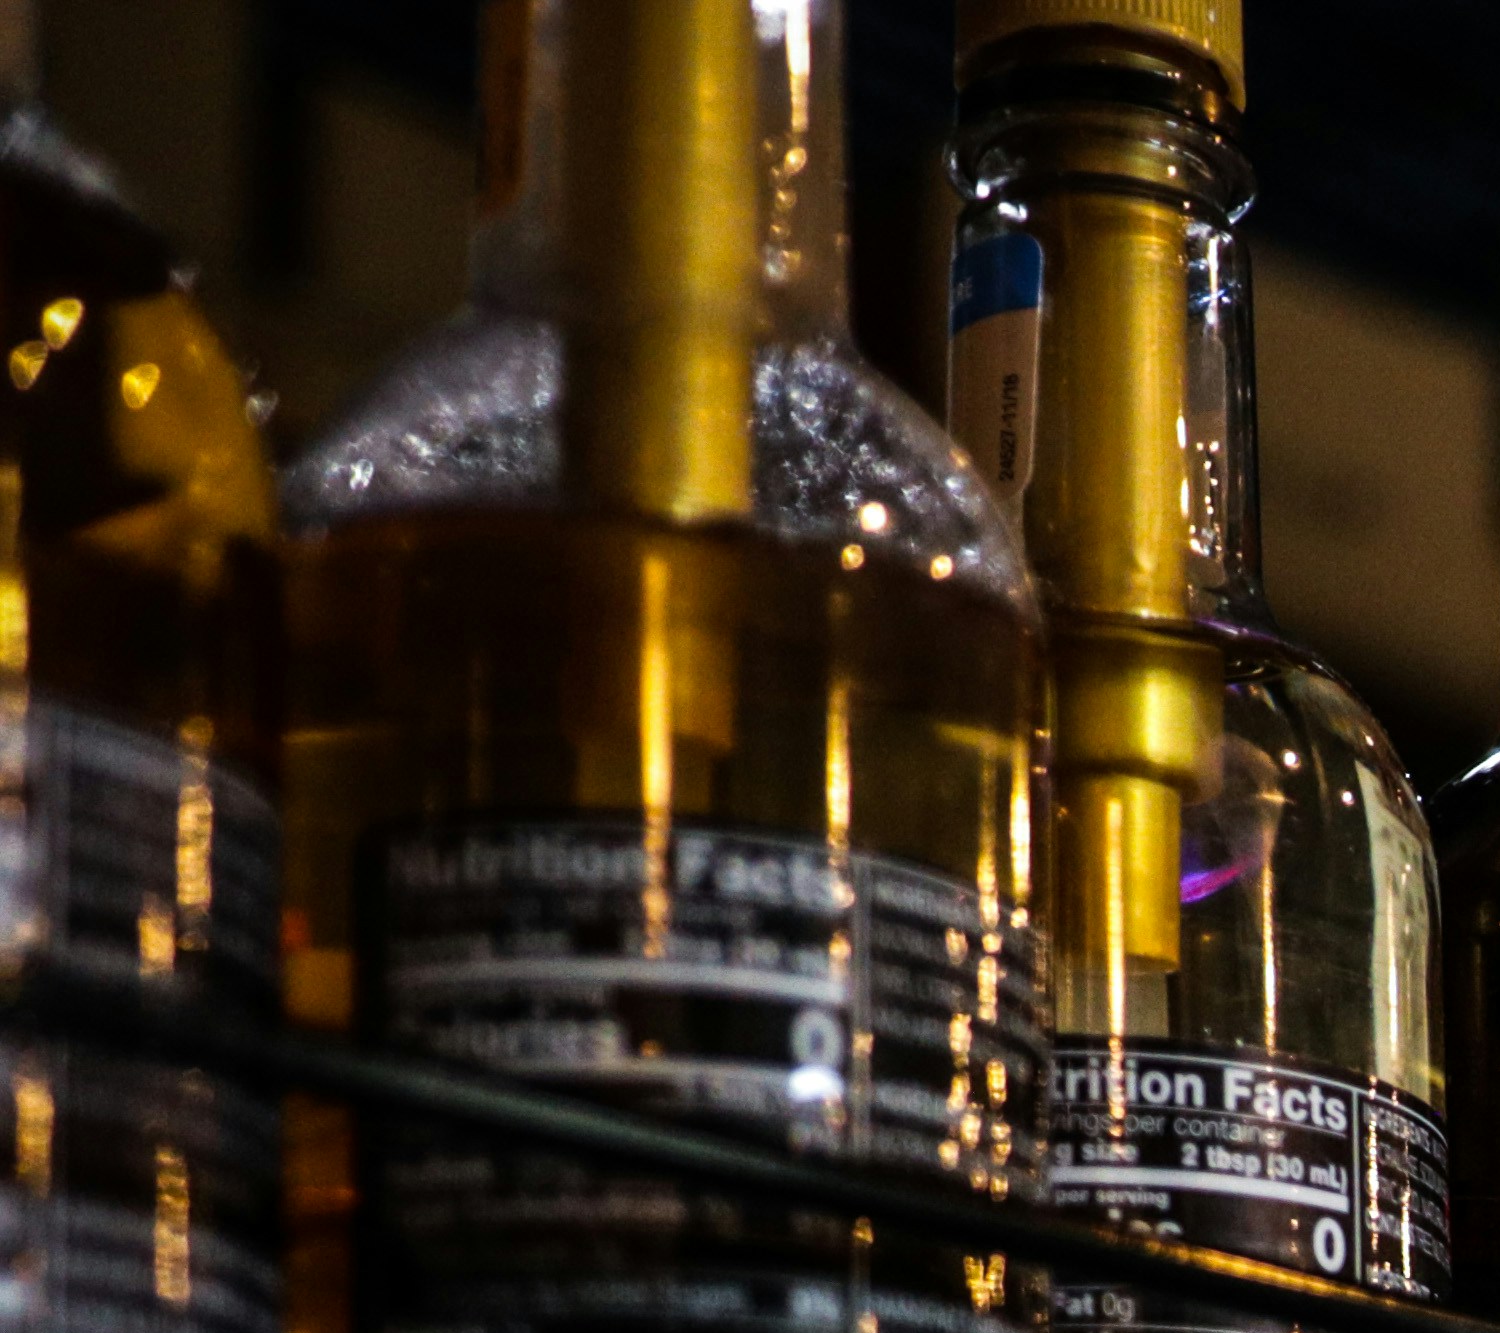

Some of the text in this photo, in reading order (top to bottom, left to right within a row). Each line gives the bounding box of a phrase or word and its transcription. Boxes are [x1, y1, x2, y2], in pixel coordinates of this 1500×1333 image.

[1223, 1067, 1348, 1132] Facts
[1125, 1113, 1286, 1148] per container
[1181, 1142, 1199, 1167] 2
[1204, 1145, 1263, 1178] tbsp
[1266, 1151, 1304, 1180] (30
[1309, 1161, 1347, 1195] mL)
[1094, 1187, 1171, 1210] serving
[1312, 1216, 1347, 1273] 0
[1102, 1292, 1136, 1325] 0g
